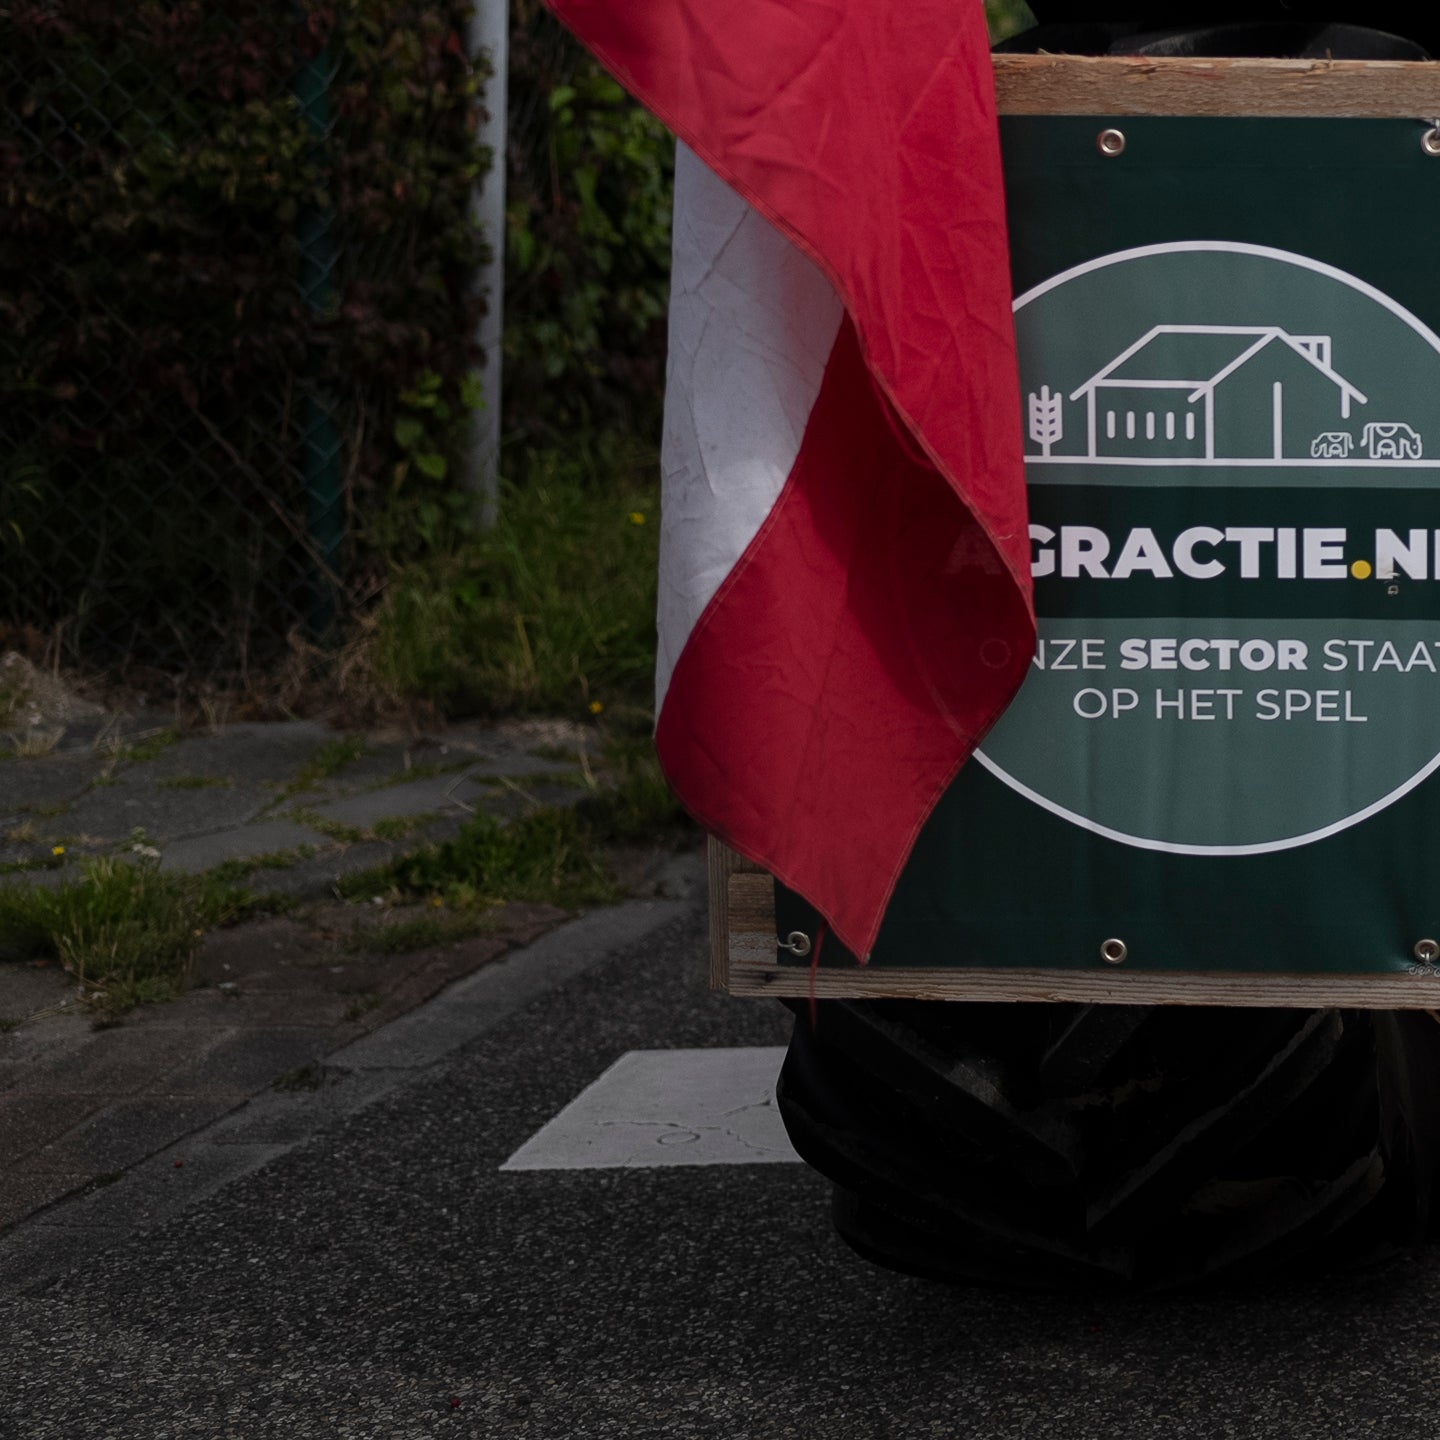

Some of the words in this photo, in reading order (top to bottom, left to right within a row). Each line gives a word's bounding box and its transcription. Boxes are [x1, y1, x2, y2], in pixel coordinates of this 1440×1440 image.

[1018, 638, 1107, 671] NZE
[1119, 637, 1309, 672] SECTOR
[1073, 687, 1139, 720] OP
[1156, 688, 1243, 721] HET
[1256, 689, 1368, 723] SPEL
